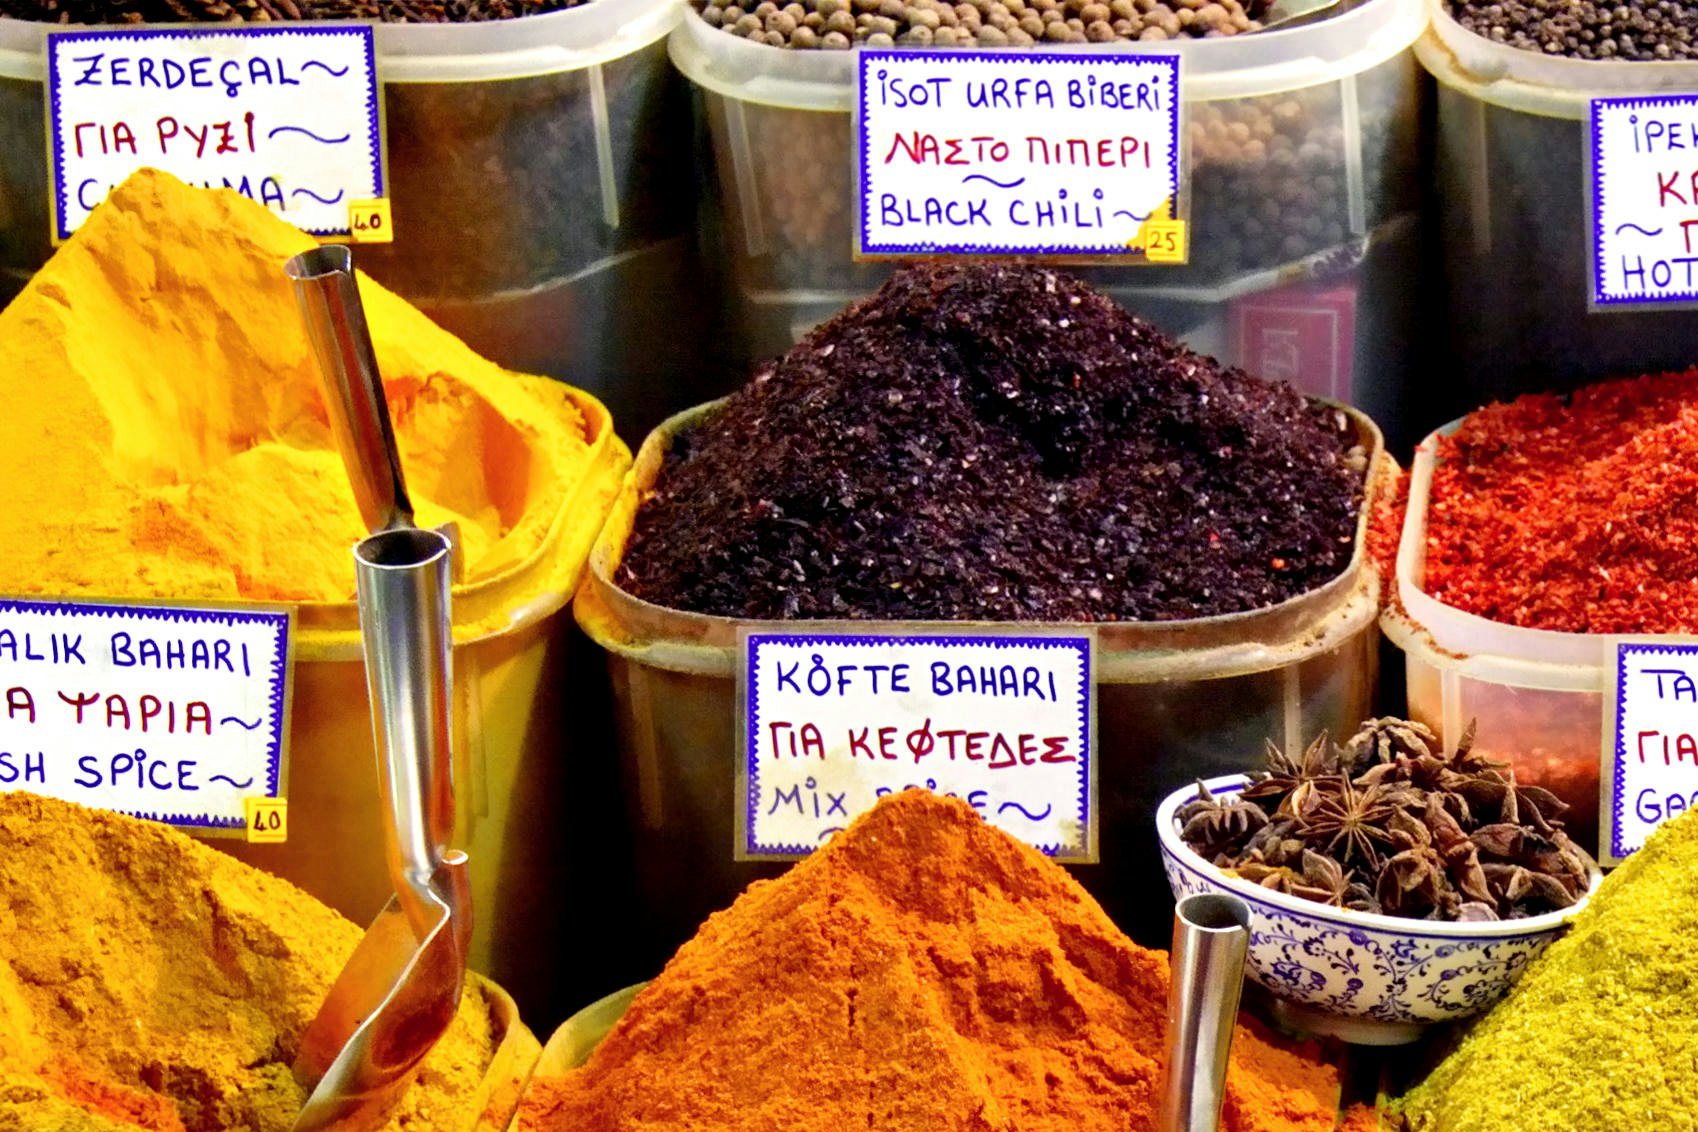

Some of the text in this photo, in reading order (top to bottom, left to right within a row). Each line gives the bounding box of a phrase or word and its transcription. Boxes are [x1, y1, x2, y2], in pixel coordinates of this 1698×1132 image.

[72, 52, 300, 99] ZERDEÇAL
[966, 77, 1055, 110] URFA
[74, 122, 137, 158] ΓΙΑ
[1025, 135, 1151, 169] ΠΙΠΕΡΙ
[353, 212, 382, 231] 40
[880, 193, 992, 227] BLACK
[1150, 230, 1177, 252] 25
[110, 631, 251, 677] BAHARI
[929, 660, 1057, 703] BAHARI
[768, 717, 1077, 770] ΓΙΑ ΚΕΦΤΕΔΕΣ
[253, 810, 281, 832] 40
